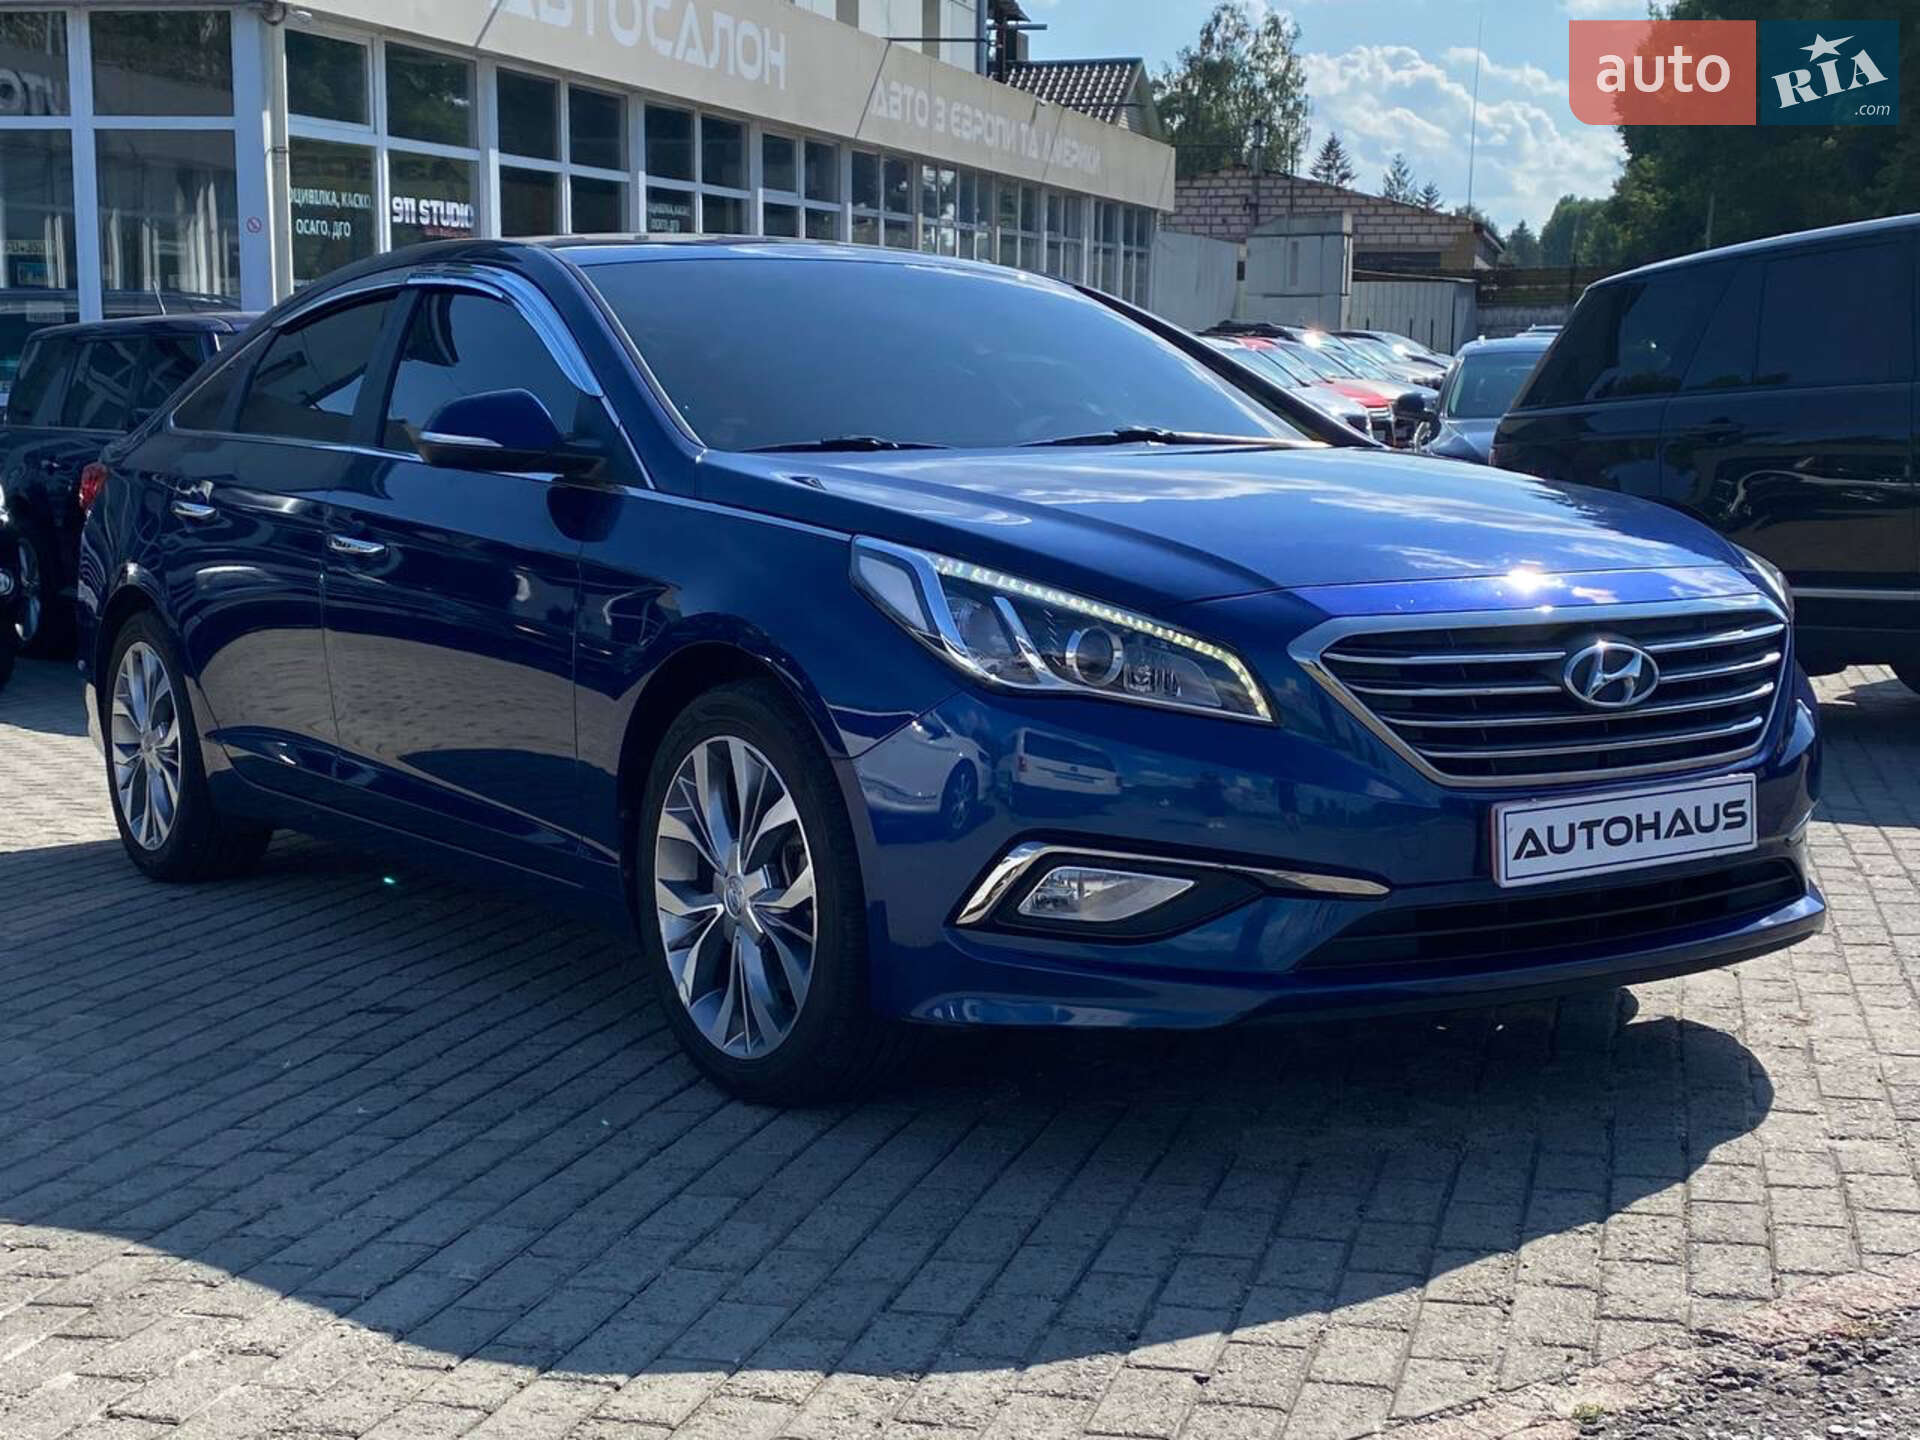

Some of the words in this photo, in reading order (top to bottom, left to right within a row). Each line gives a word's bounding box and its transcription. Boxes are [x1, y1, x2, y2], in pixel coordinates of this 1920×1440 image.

[497, 0, 786, 90] ОСАЛОН
[871, 76, 930, 128] АВТО
[392, 196, 417, 224] 911
[419, 198, 475, 229] STUDIO
[1512, 799, 1749, 861] AUTOHAUS
